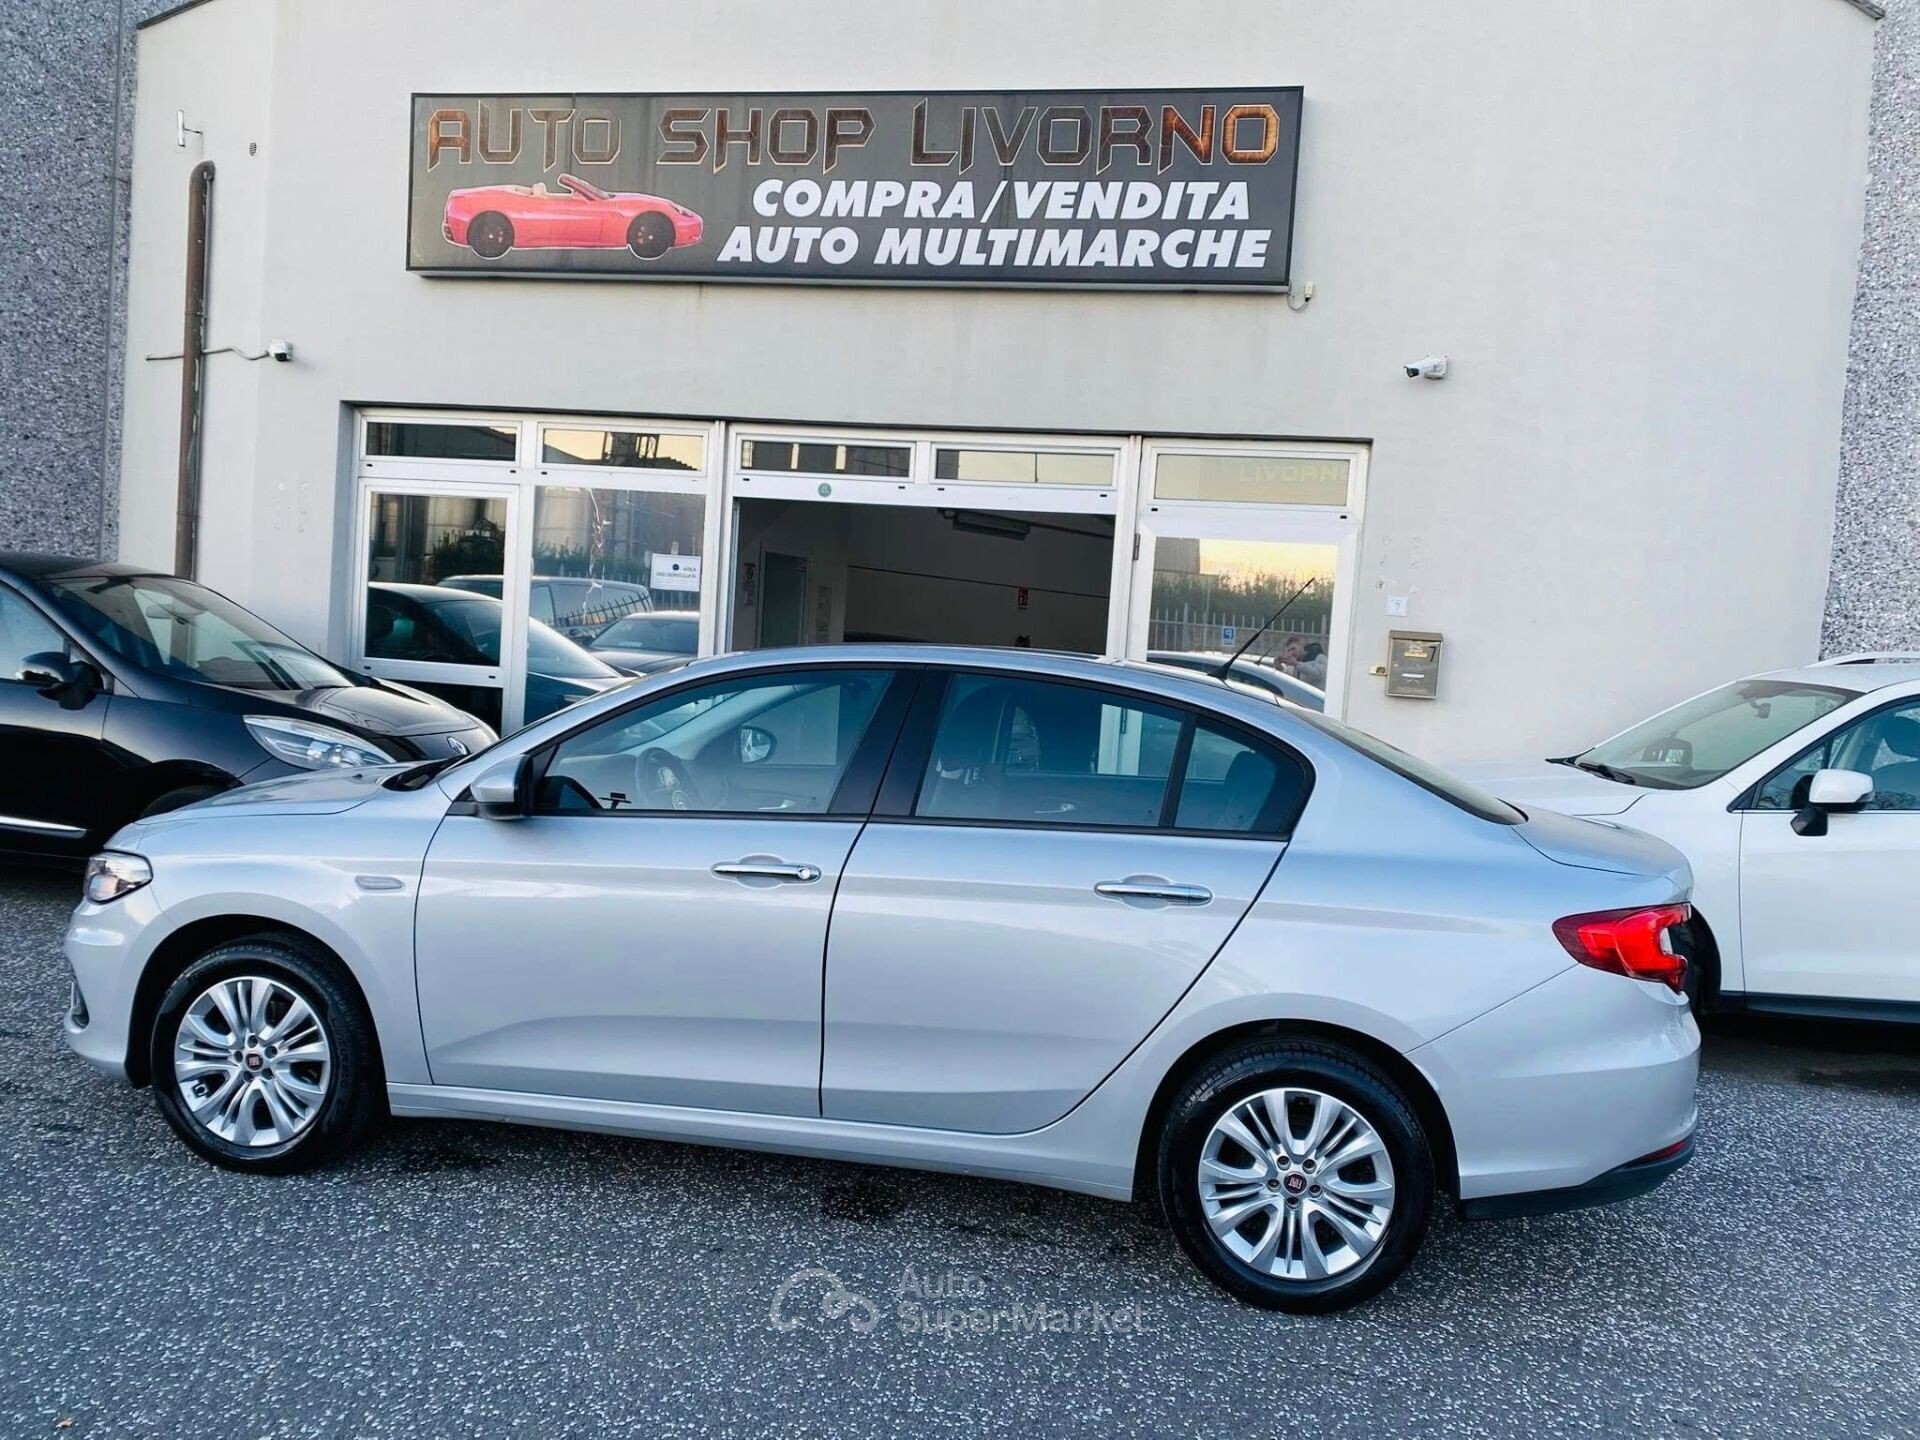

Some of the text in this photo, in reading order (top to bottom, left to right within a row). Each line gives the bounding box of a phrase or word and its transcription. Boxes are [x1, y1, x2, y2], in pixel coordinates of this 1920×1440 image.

[427, 97, 1281, 175] AUTO SHOP LIVORNO
[752, 178, 1250, 224] COMPRA/VENDITA
[717, 225, 1272, 269] AUTO MULTIMARCHE
[1429, 646, 1437, 662] 7
